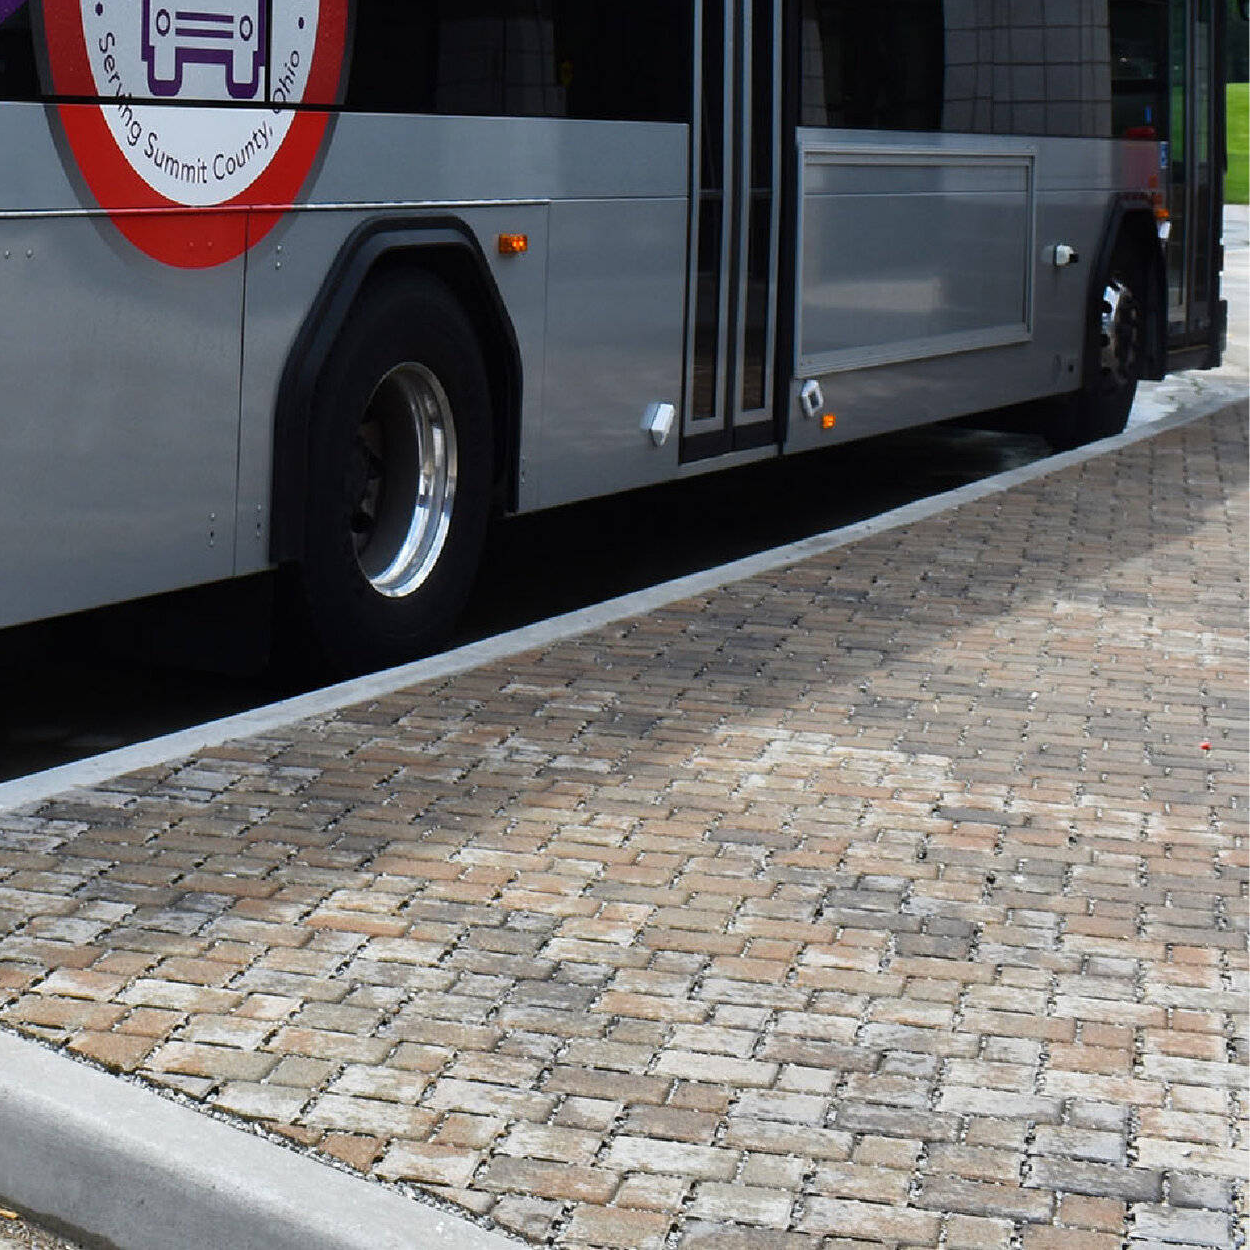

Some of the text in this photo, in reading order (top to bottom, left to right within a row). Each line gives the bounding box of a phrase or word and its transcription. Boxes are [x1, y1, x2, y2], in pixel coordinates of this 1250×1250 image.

[143, 132, 207, 184] Summit
[213, 121, 274, 181] County,
[272, 50, 300, 114] Ohio
